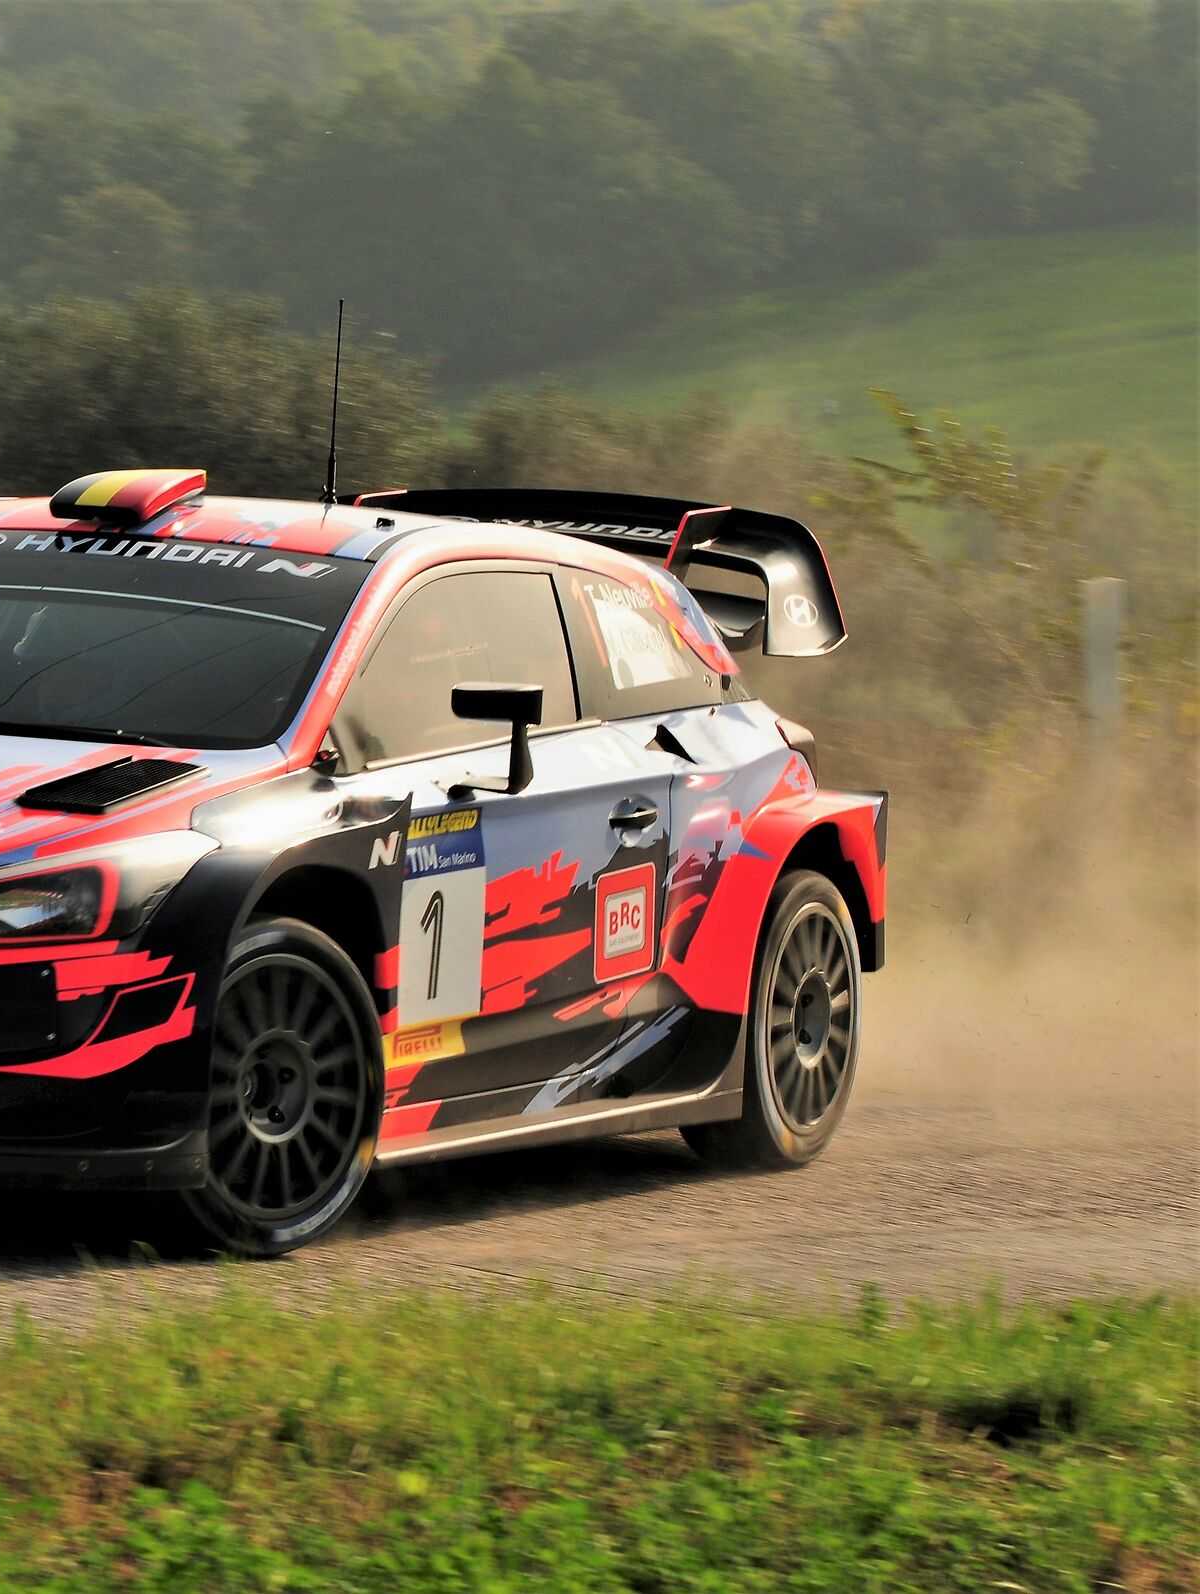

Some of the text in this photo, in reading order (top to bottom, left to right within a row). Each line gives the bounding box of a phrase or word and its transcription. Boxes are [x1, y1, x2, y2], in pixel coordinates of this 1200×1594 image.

[14, 534, 338, 579] HYUNDAI N
[598, 581, 654, 609] Neuville
[369, 830, 402, 870] N
[406, 844, 477, 873] TIM San Marino
[609, 902, 640, 937] BRC
[420, 889, 444, 1000] 1
[392, 1023, 442, 1059] PIRELLI
